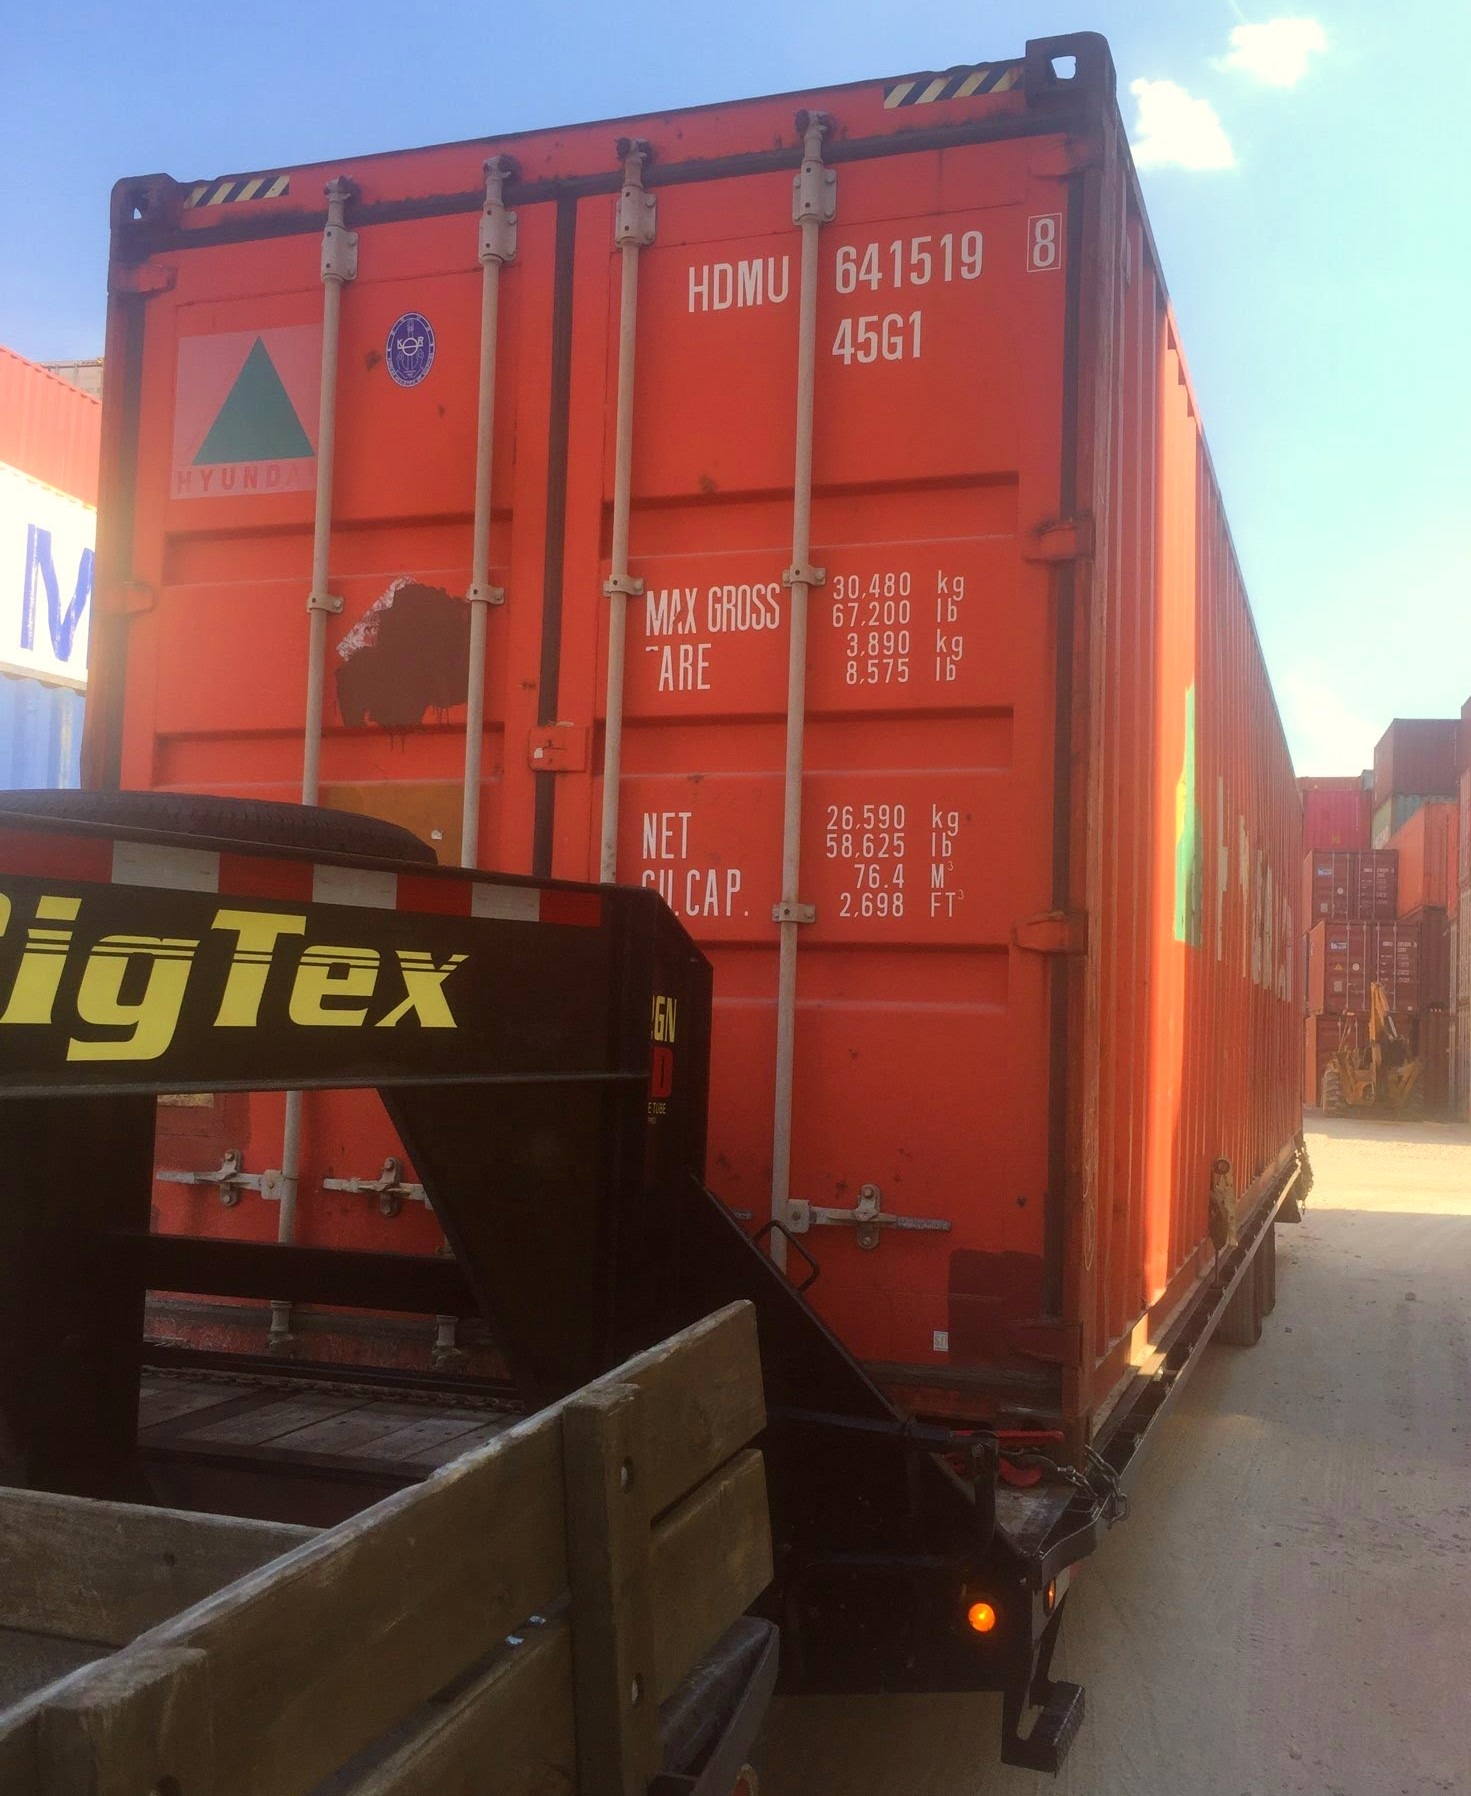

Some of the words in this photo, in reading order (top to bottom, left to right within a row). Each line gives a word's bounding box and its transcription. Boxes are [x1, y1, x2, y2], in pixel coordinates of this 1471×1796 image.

[688, 255, 790, 313] HDMU
[835, 230, 984, 294] 641519
[1032, 217, 1056, 267] 8
[832, 310, 922, 365] 45G1
[177, 463, 316, 494] HYUNDA
[645, 587, 698, 636] MAX
[707, 582, 780, 633] GROSS
[833, 571, 911, 600] 30,480
[937, 569, 965, 602] kg
[832, 599, 911, 628] 67,200
[937, 600, 958, 623] lb
[645, 643, 712, 692] ARE
[846, 630, 910, 658] 3,890
[936, 628, 963, 660] kg
[846, 657, 909, 685] 8,575
[935, 657, 957, 682] lb
[642, 811, 692, 860] NET
[826, 804, 905, 831] 26,590
[931, 803, 959, 836] kg
[826, 832, 905, 858] 58,625
[931, 832, 953, 858] lb
[854, 863, 905, 889] 76.4
[839, 892, 904, 918] 2,698
